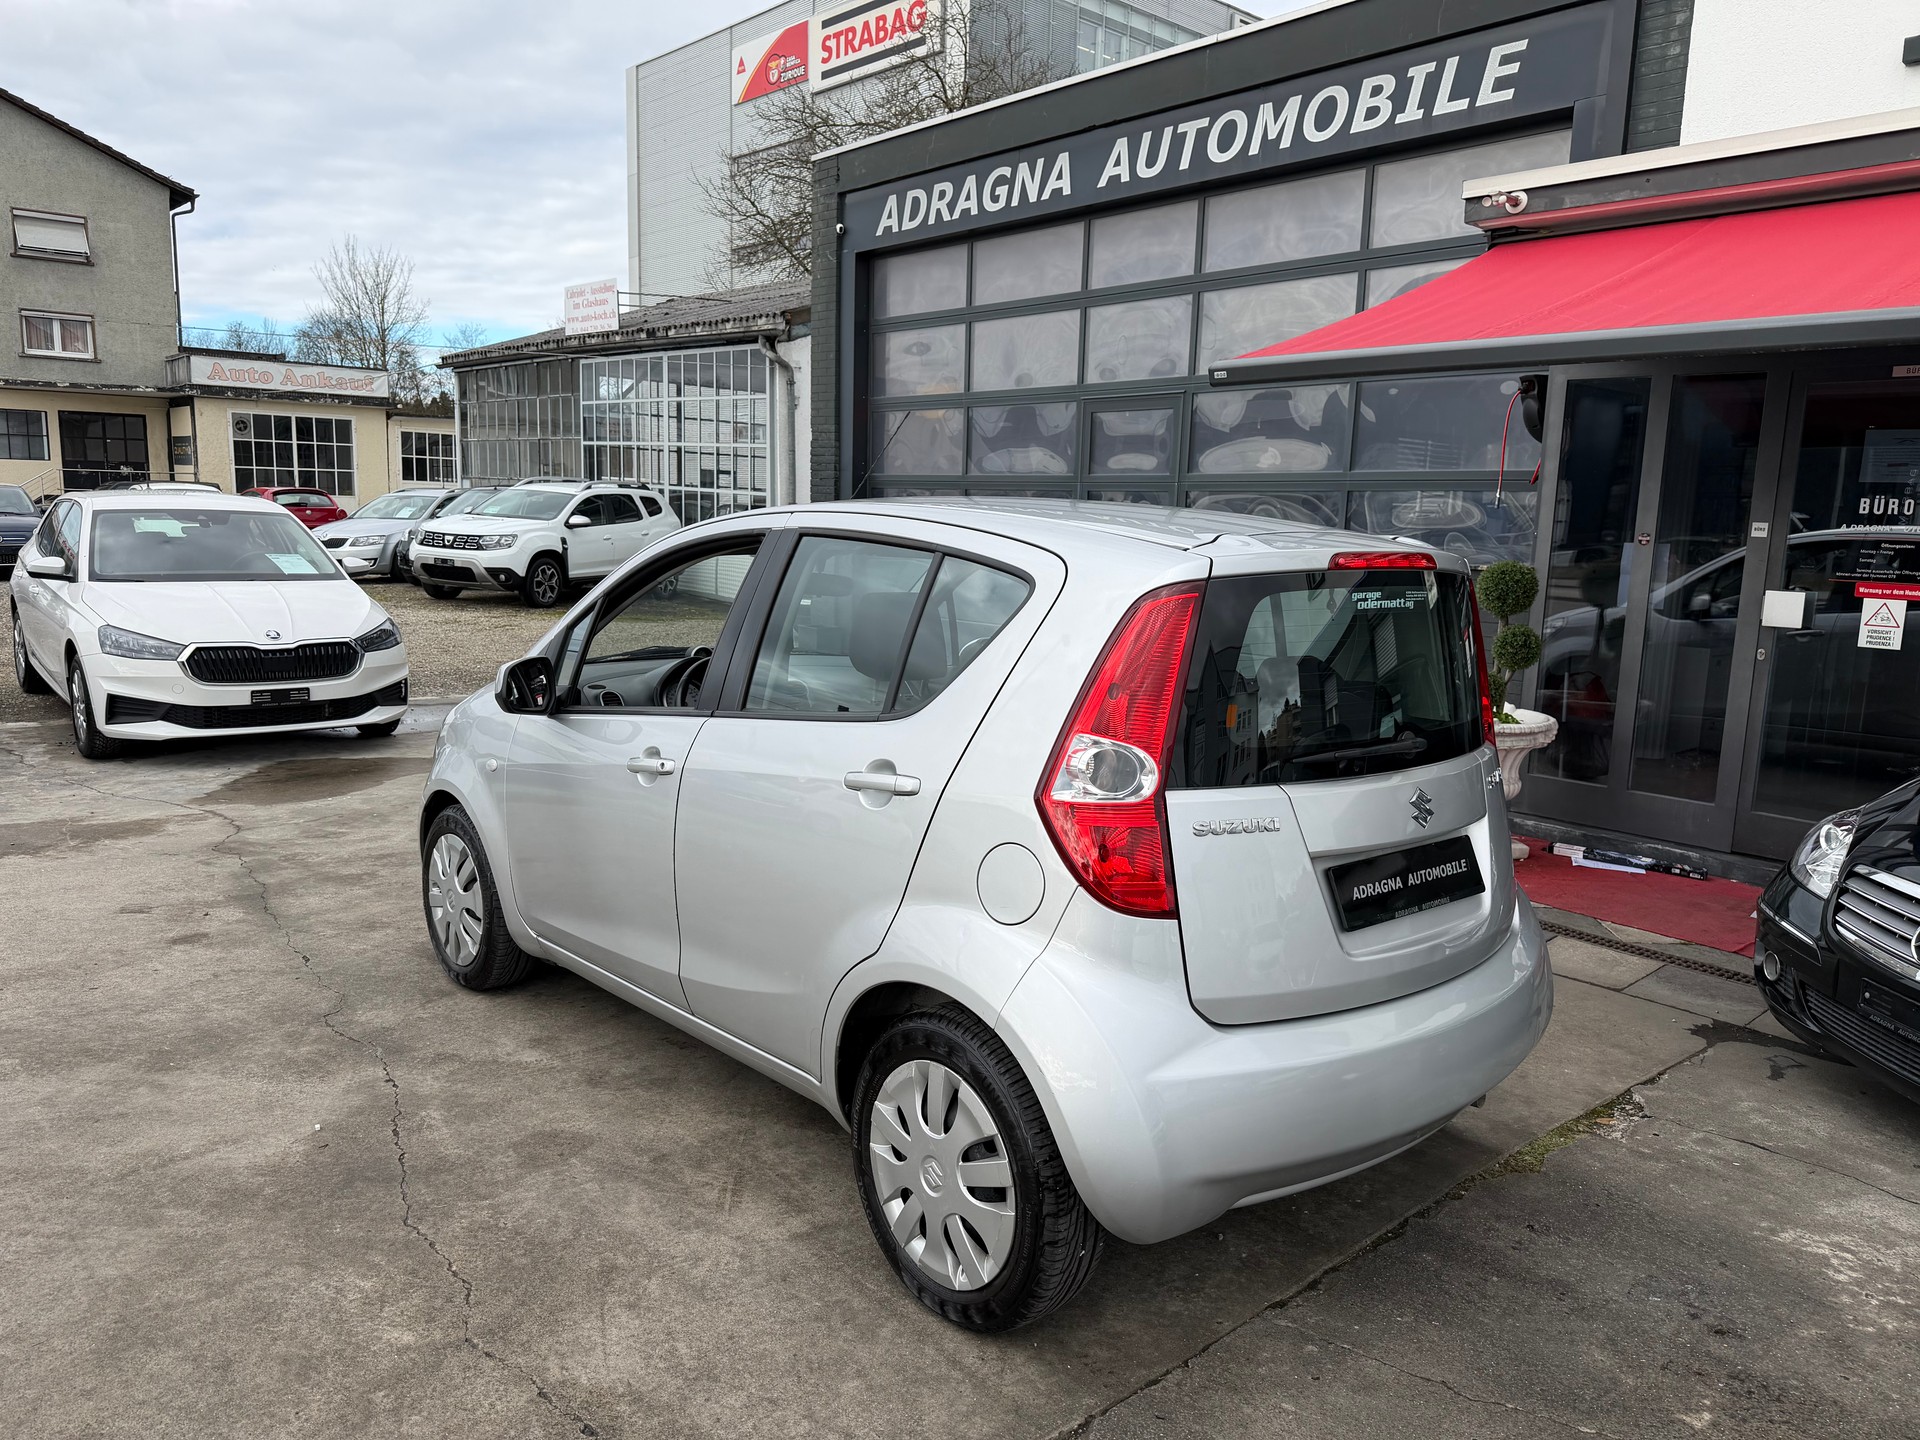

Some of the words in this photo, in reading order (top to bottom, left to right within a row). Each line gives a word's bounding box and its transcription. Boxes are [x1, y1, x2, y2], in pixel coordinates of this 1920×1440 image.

[821, 0, 927, 64] STRABAG
[875, 151, 1072, 237] ADRAGNA
[1097, 38, 1530, 188] AUTOMOBILE
[573, 300, 580, 309] im
[582, 297, 609, 308] Glashaus
[567, 308, 616, 323] www.auto-koch.ch
[207, 362, 274, 385] Auto
[280, 368, 375, 392] Ankauf
[1859, 496, 1914, 516] BÜRO
[1352, 591, 1381, 601] garage
[1859, 587, 1882, 595] Warnung
[1357, 599, 1405, 609] odermatt
[1192, 817, 1280, 837] SUZUKI
[1352, 876, 1403, 900] ADRAGNA
[1408, 859, 1468, 886] AUTOMOBILE
[1395, 905, 1419, 918] ADRAGNA
[1422, 896, 1450, 910] AUTOMOBILE
[1869, 1014, 1895, 1031] ADRAGNA
